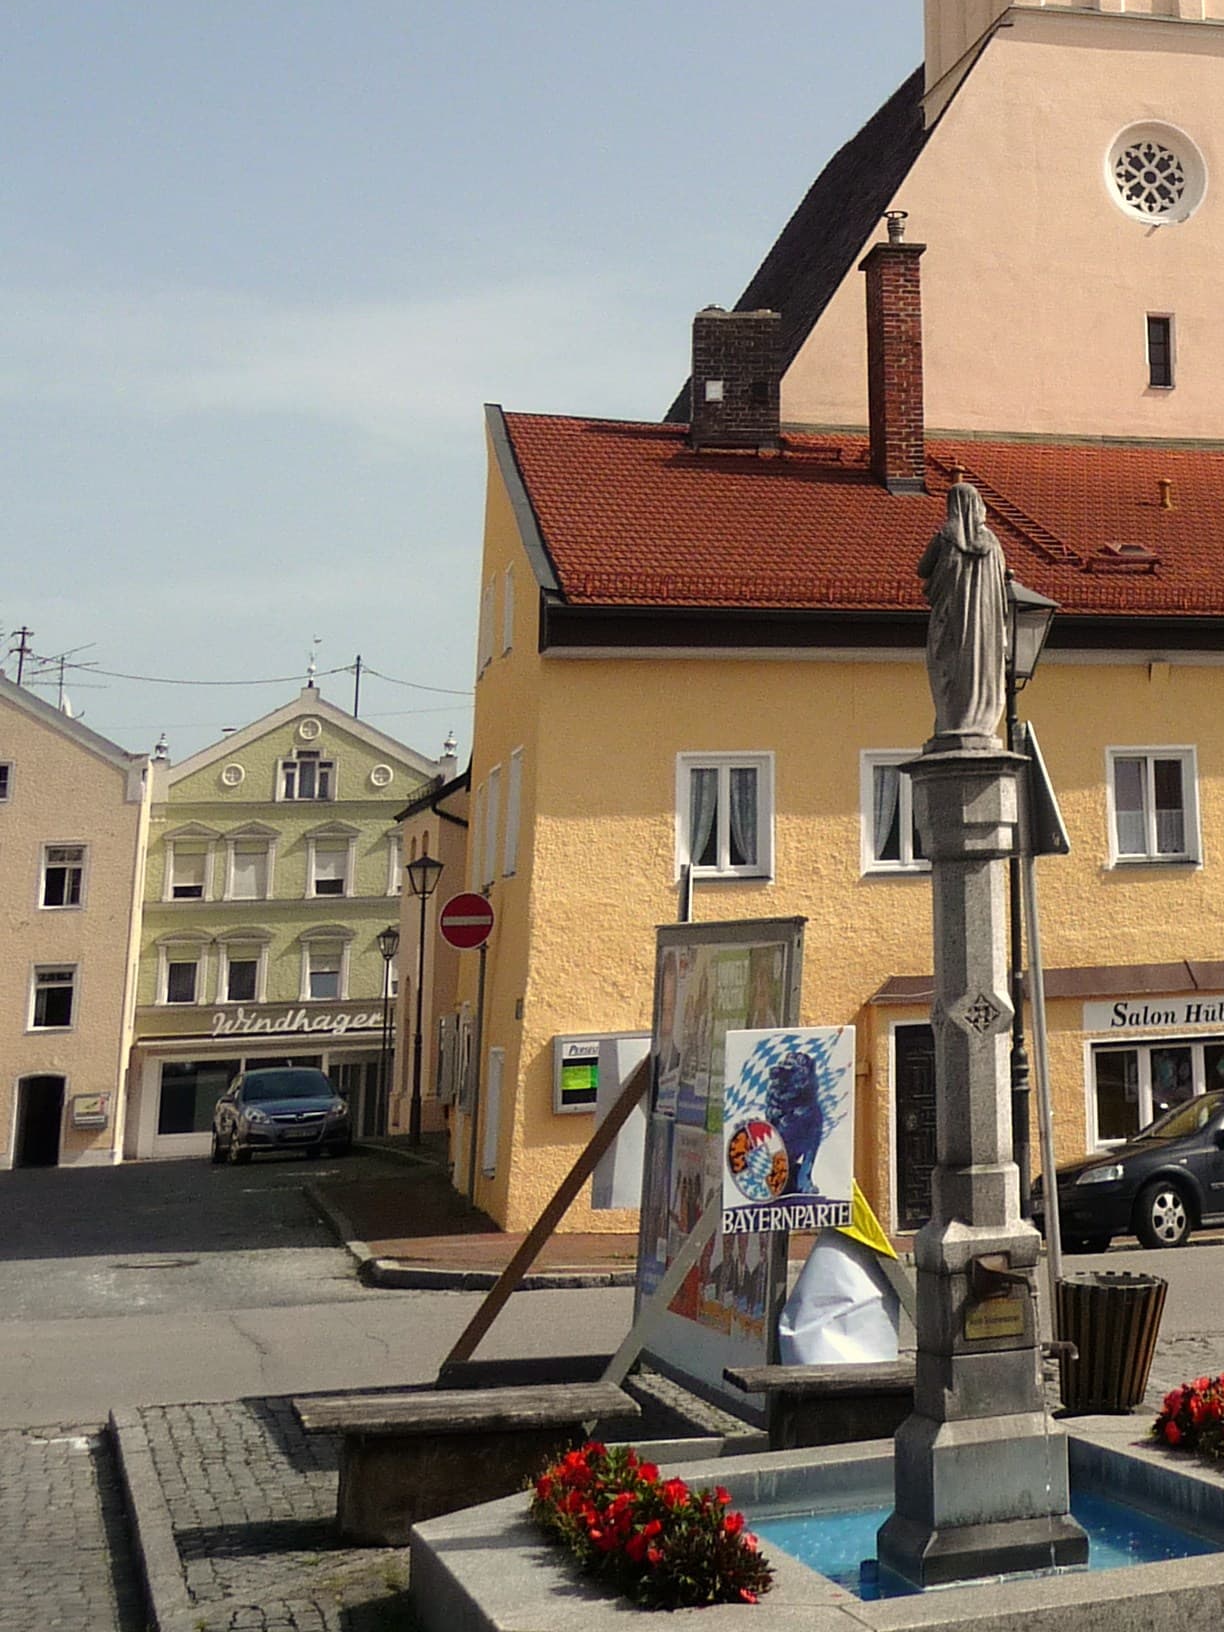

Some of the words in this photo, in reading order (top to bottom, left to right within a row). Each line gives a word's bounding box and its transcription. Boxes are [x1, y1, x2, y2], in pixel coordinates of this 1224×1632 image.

[212, 1007, 384, 1036] Windhager
[1110, 1002, 1177, 1027] Salon
[722, 1202, 853, 1234] BAYERNPARTEI
